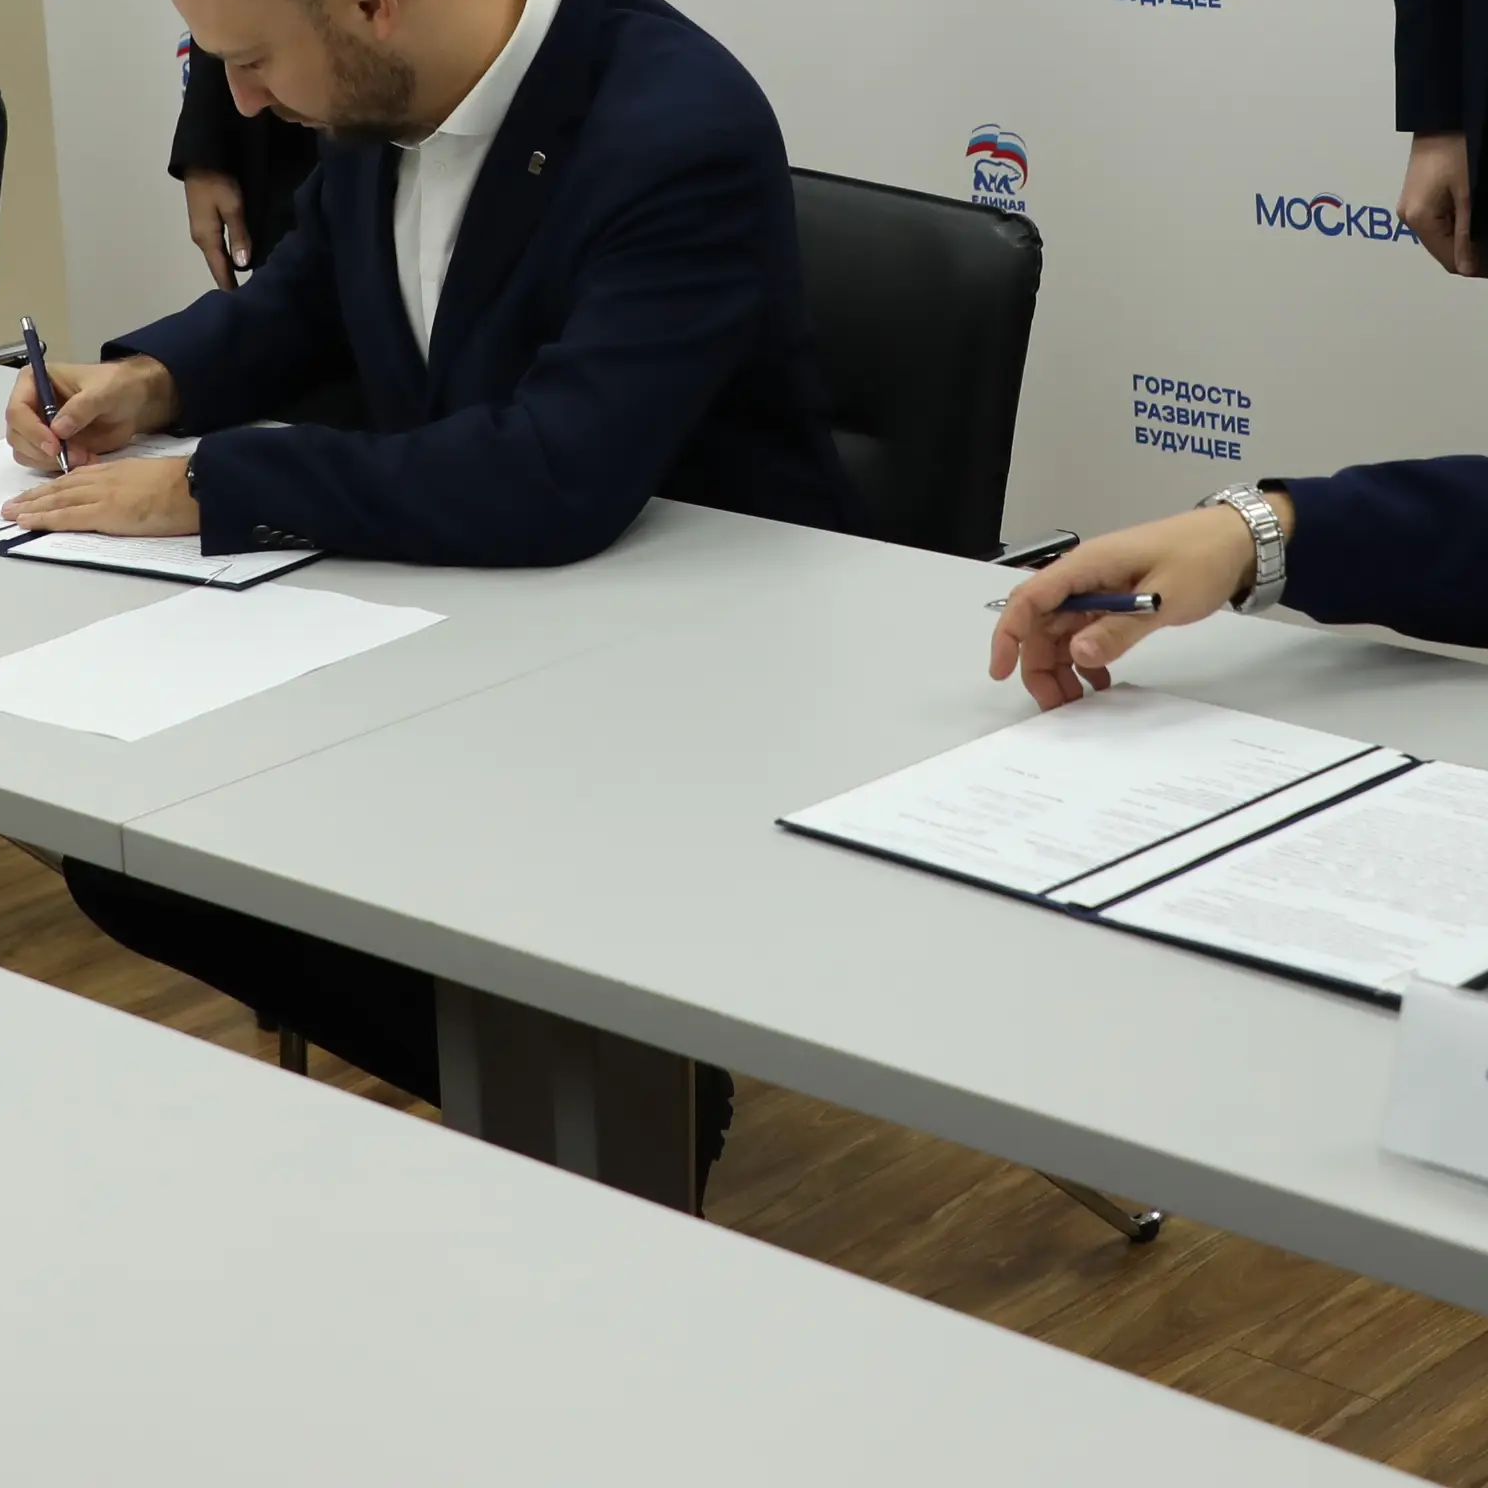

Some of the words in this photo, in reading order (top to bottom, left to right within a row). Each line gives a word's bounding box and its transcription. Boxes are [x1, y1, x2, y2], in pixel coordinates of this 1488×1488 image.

[1133, 374, 1251, 408] ГОРДОСТЬ
[1134, 401, 1250, 435] РАЗВИТИЕ
[1136, 426, 1241, 460] БУДУЩЕЕ
